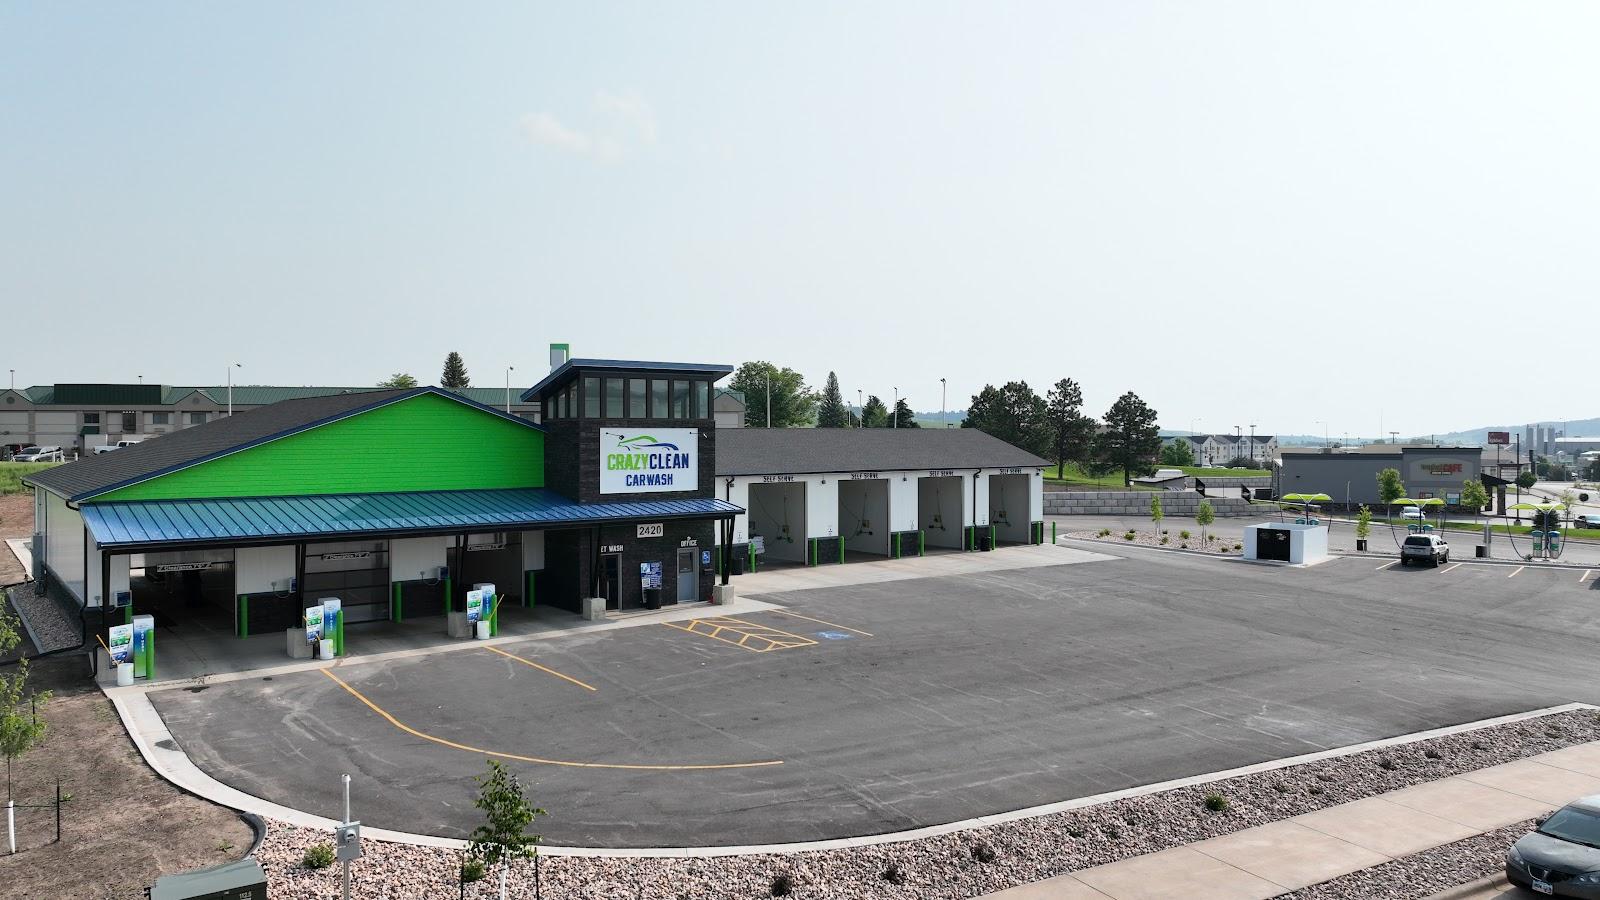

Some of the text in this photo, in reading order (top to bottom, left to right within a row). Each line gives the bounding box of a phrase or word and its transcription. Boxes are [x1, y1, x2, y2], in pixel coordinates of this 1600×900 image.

[626, 473, 673, 487] CARWASH
[639, 525, 662, 536] 2420
[609, 544, 624, 552] WASH
